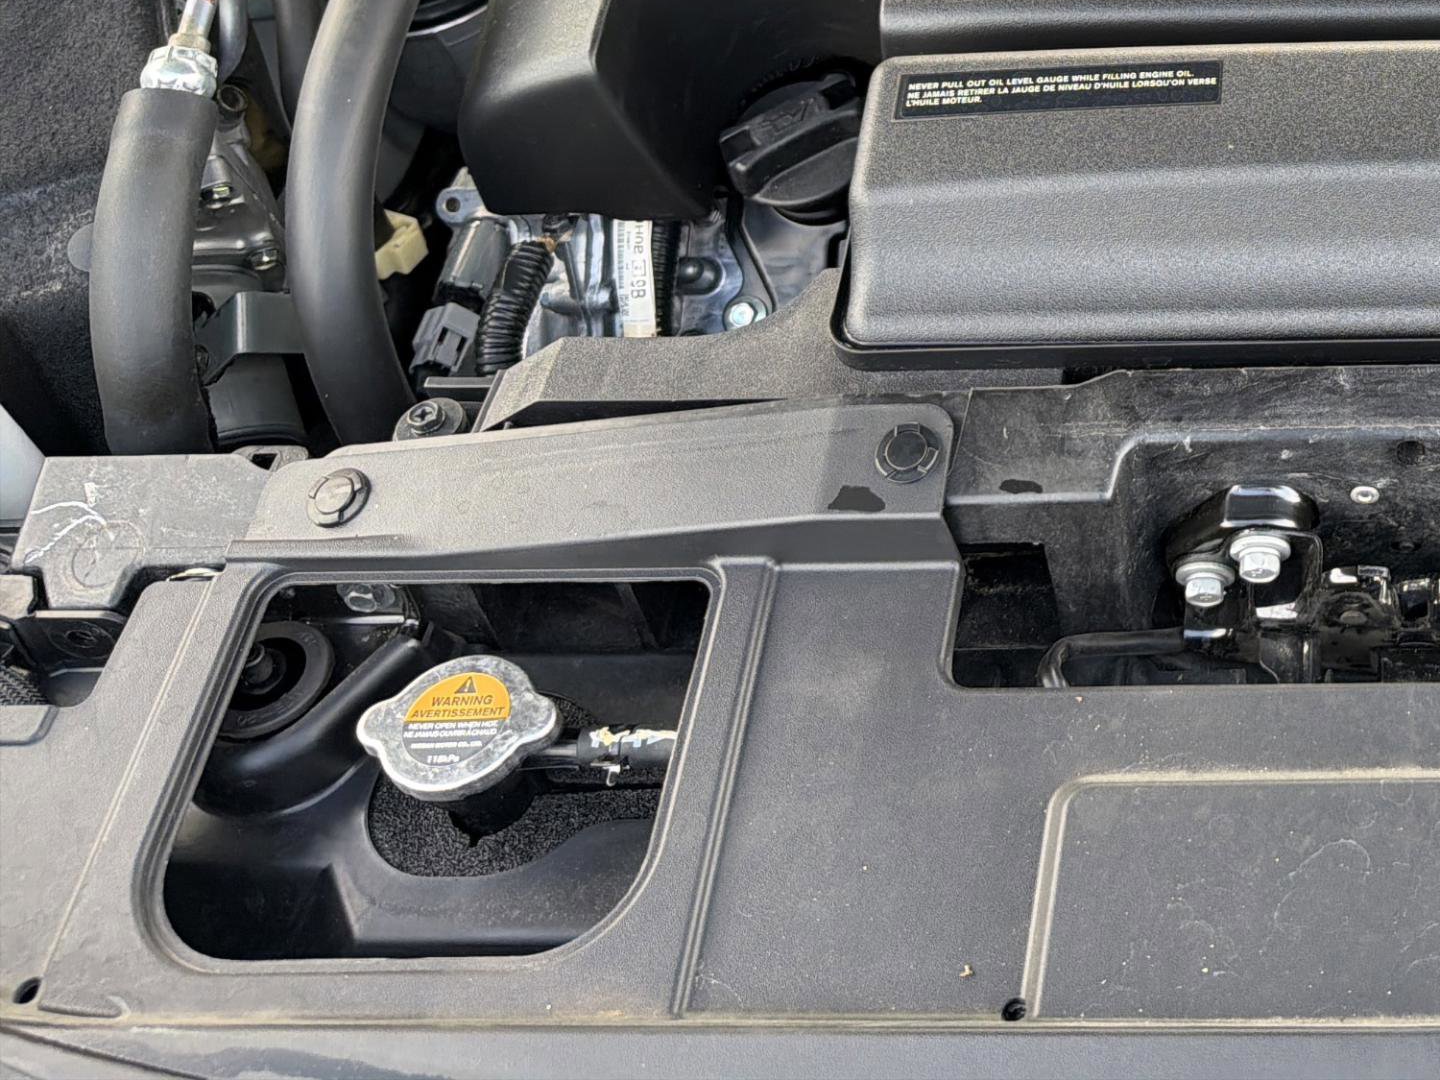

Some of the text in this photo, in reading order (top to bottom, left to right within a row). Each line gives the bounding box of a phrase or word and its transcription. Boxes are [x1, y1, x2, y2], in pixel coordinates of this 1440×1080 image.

[908, 69, 1195, 91] NEVER PULL OUT OIL LEVEL GAUGE WHILE FILLING ENGINE OIL.
[907, 77, 1218, 99] NE JAMAIS RETIRER LA JAUGE DE NIVEAU D'HUILE LORSQU'ON VERSE
[906, 96, 983, 107] L'HUILE MOTEUR.
[431, 694, 494, 707] WARNING
[410, 706, 506, 719] AVERTISSEMENT
